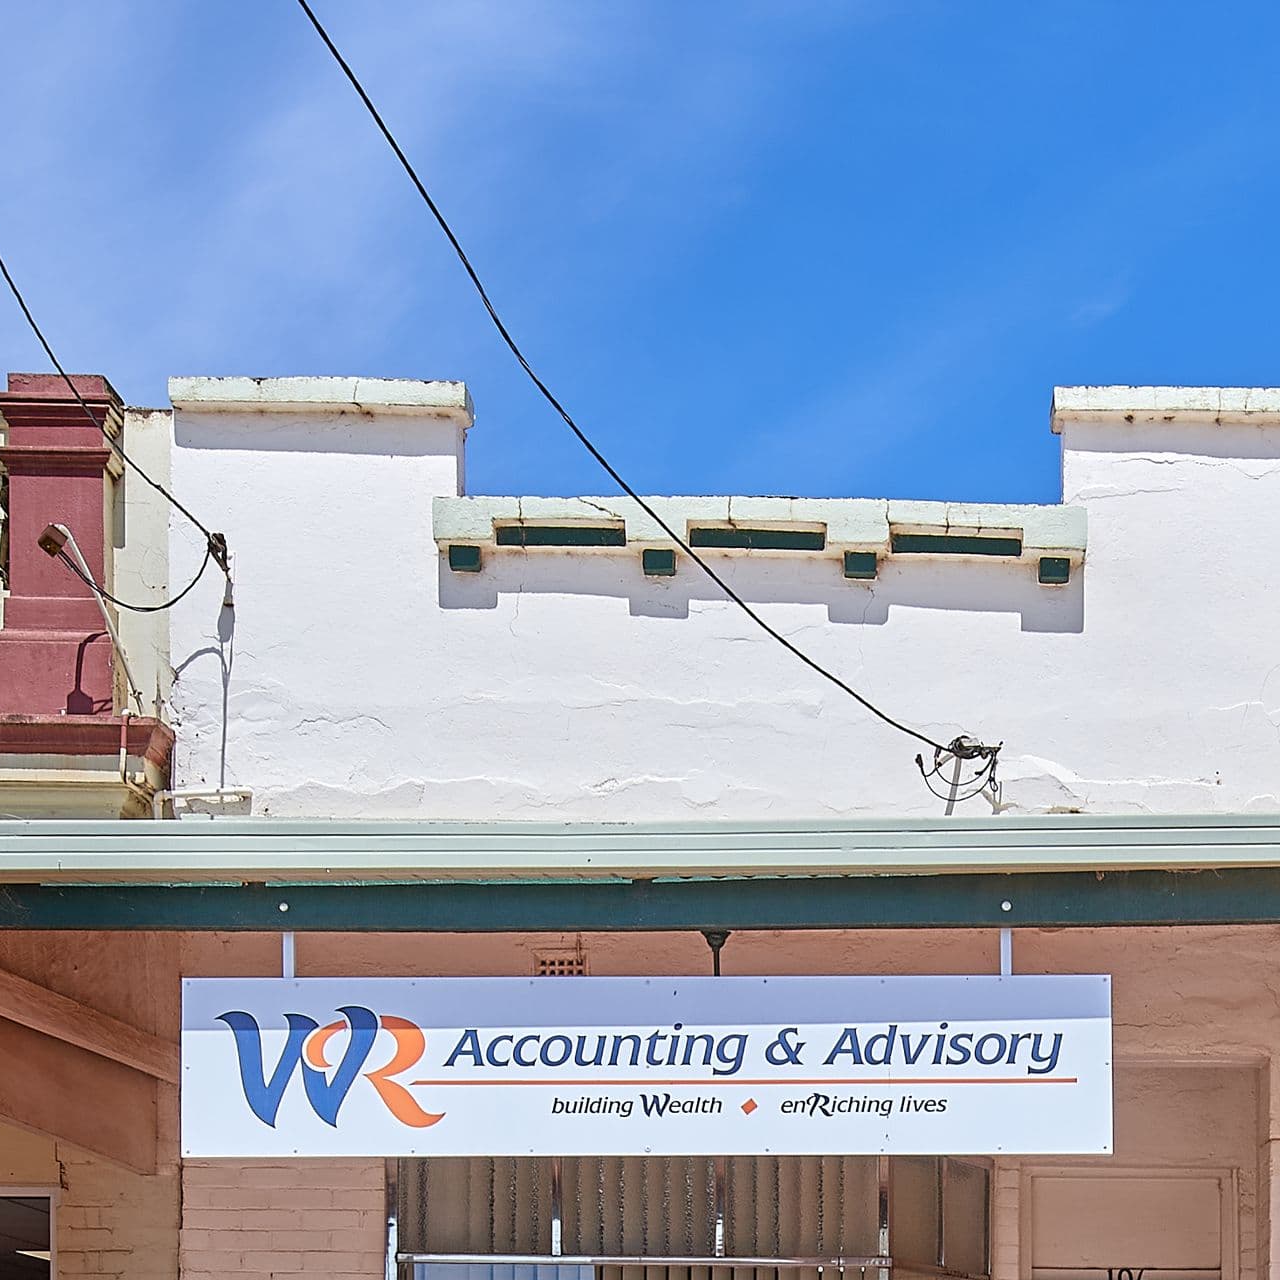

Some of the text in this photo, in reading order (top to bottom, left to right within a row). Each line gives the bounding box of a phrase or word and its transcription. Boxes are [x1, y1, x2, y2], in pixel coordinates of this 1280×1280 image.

[444, 1021, 1063, 1076] Accounting & Advisory
[551, 1092, 948, 1118] building Wealth enRiching lives
